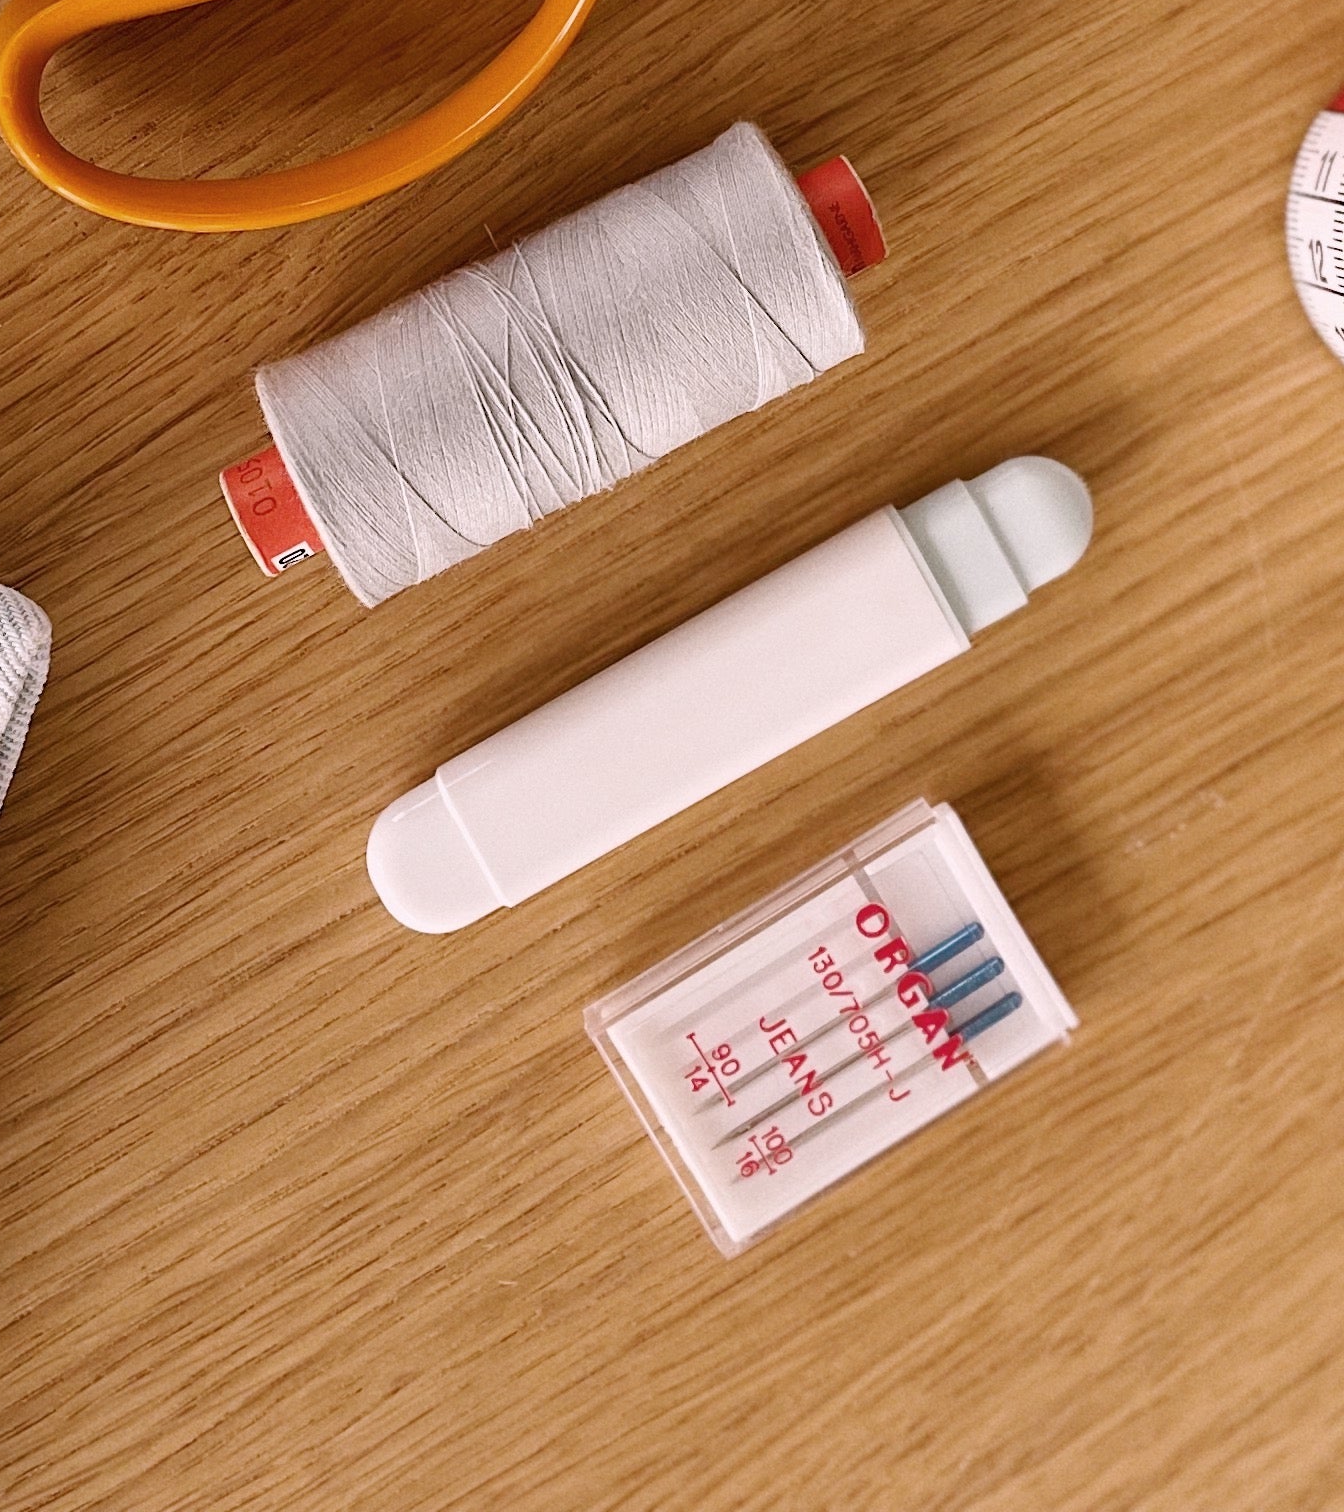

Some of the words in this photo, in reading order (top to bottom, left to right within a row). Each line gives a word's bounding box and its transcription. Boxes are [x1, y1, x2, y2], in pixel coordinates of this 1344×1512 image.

[1308, 238, 1329, 284] 12
[855, 903, 970, 1072] ORGAN
[683, 1064, 709, 1093] 14
[710, 1042, 742, 1077] 90
[758, 1015, 834, 1117] JEANS
[735, 1151, 760, 1179] 16
[760, 1125, 794, 1166] 100
